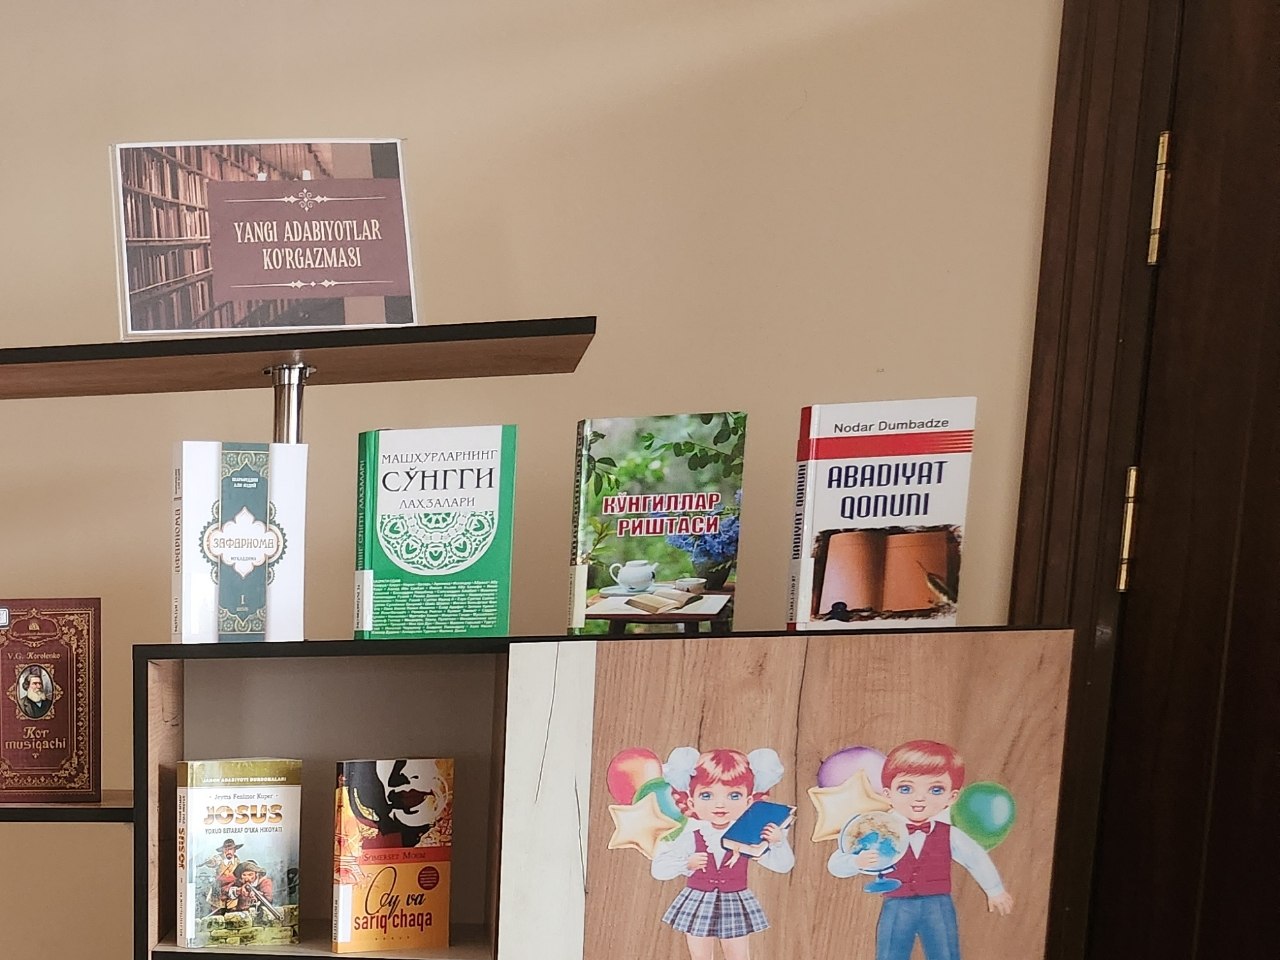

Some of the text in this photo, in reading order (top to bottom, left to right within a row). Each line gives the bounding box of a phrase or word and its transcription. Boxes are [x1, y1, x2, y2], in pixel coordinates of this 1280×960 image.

[233, 219, 383, 243] YANGI ADABIYOTLAR
[262, 247, 362, 270] KO'RGAZMASI
[834, 418, 949, 433] Nodar Dumbadze
[382, 466, 495, 492] СЎНГГИ
[827, 461, 949, 488] ABADIYAT
[602, 492, 721, 514] КЎНГИЛЛАР
[841, 493, 930, 520] QONUNI
[617, 515, 721, 537] РИШТАСИ
[23, 726, 50, 739] Kor
[203, 804, 283, 825] JOSUS
[406, 892, 426, 906] va
[354, 913, 387, 934] sariq
[393, 911, 433, 932] chaqa
